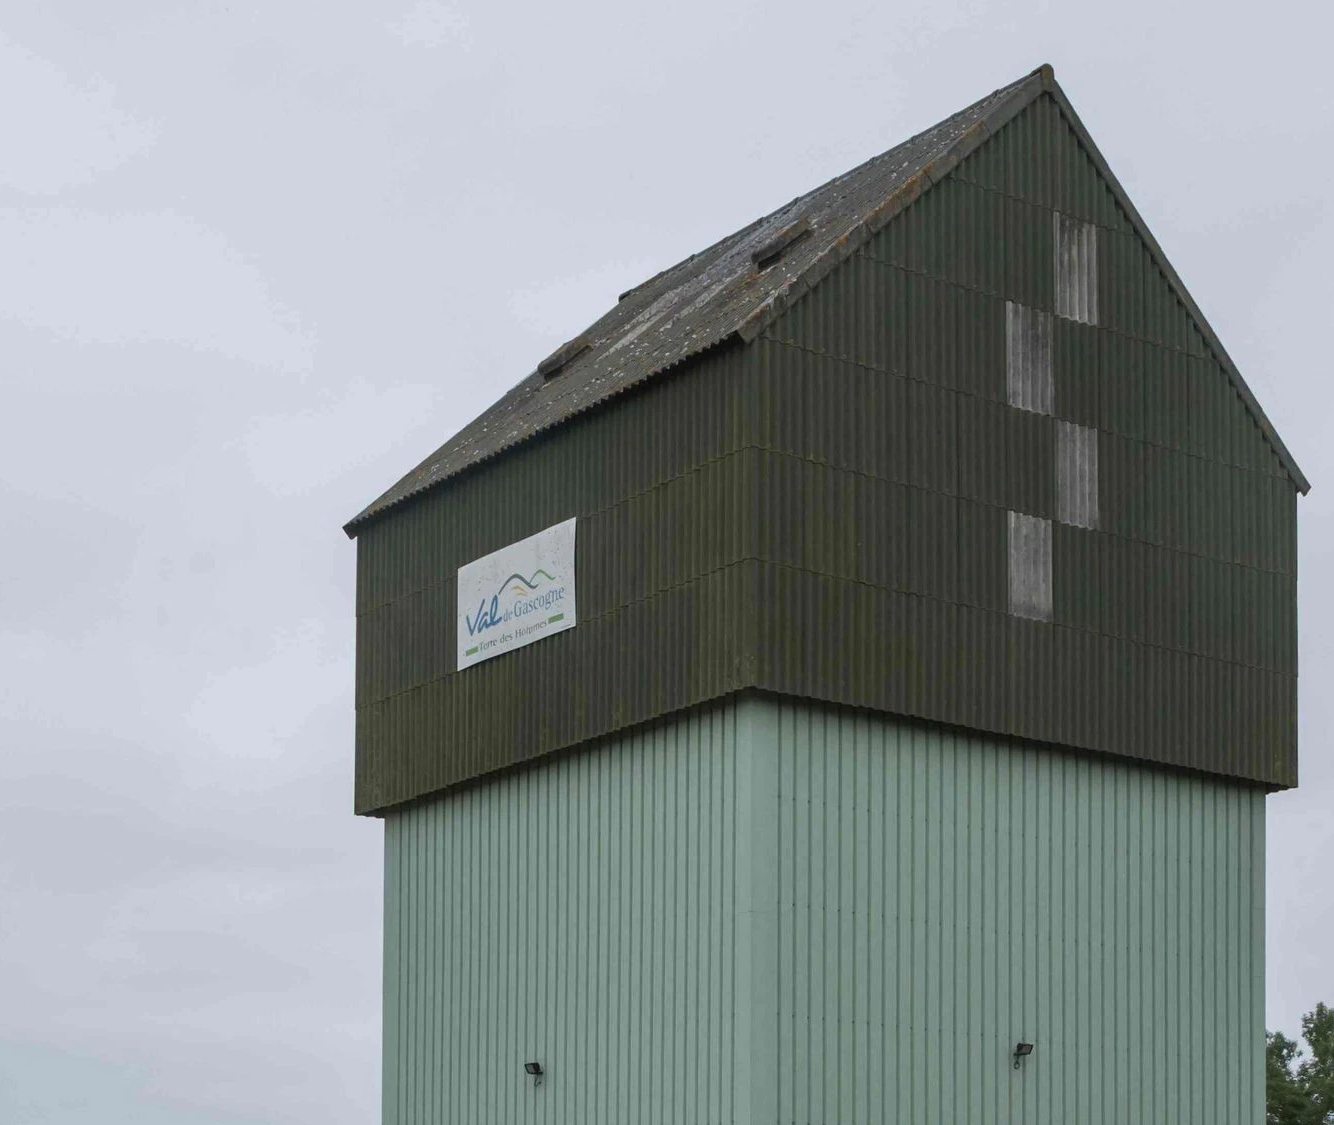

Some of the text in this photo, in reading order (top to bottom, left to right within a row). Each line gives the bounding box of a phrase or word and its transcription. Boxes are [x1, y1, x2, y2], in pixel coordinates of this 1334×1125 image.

[466, 587, 565, 637] Val de Gascogne
[479, 638, 497, 651] Terre
[500, 632, 513, 644] des
